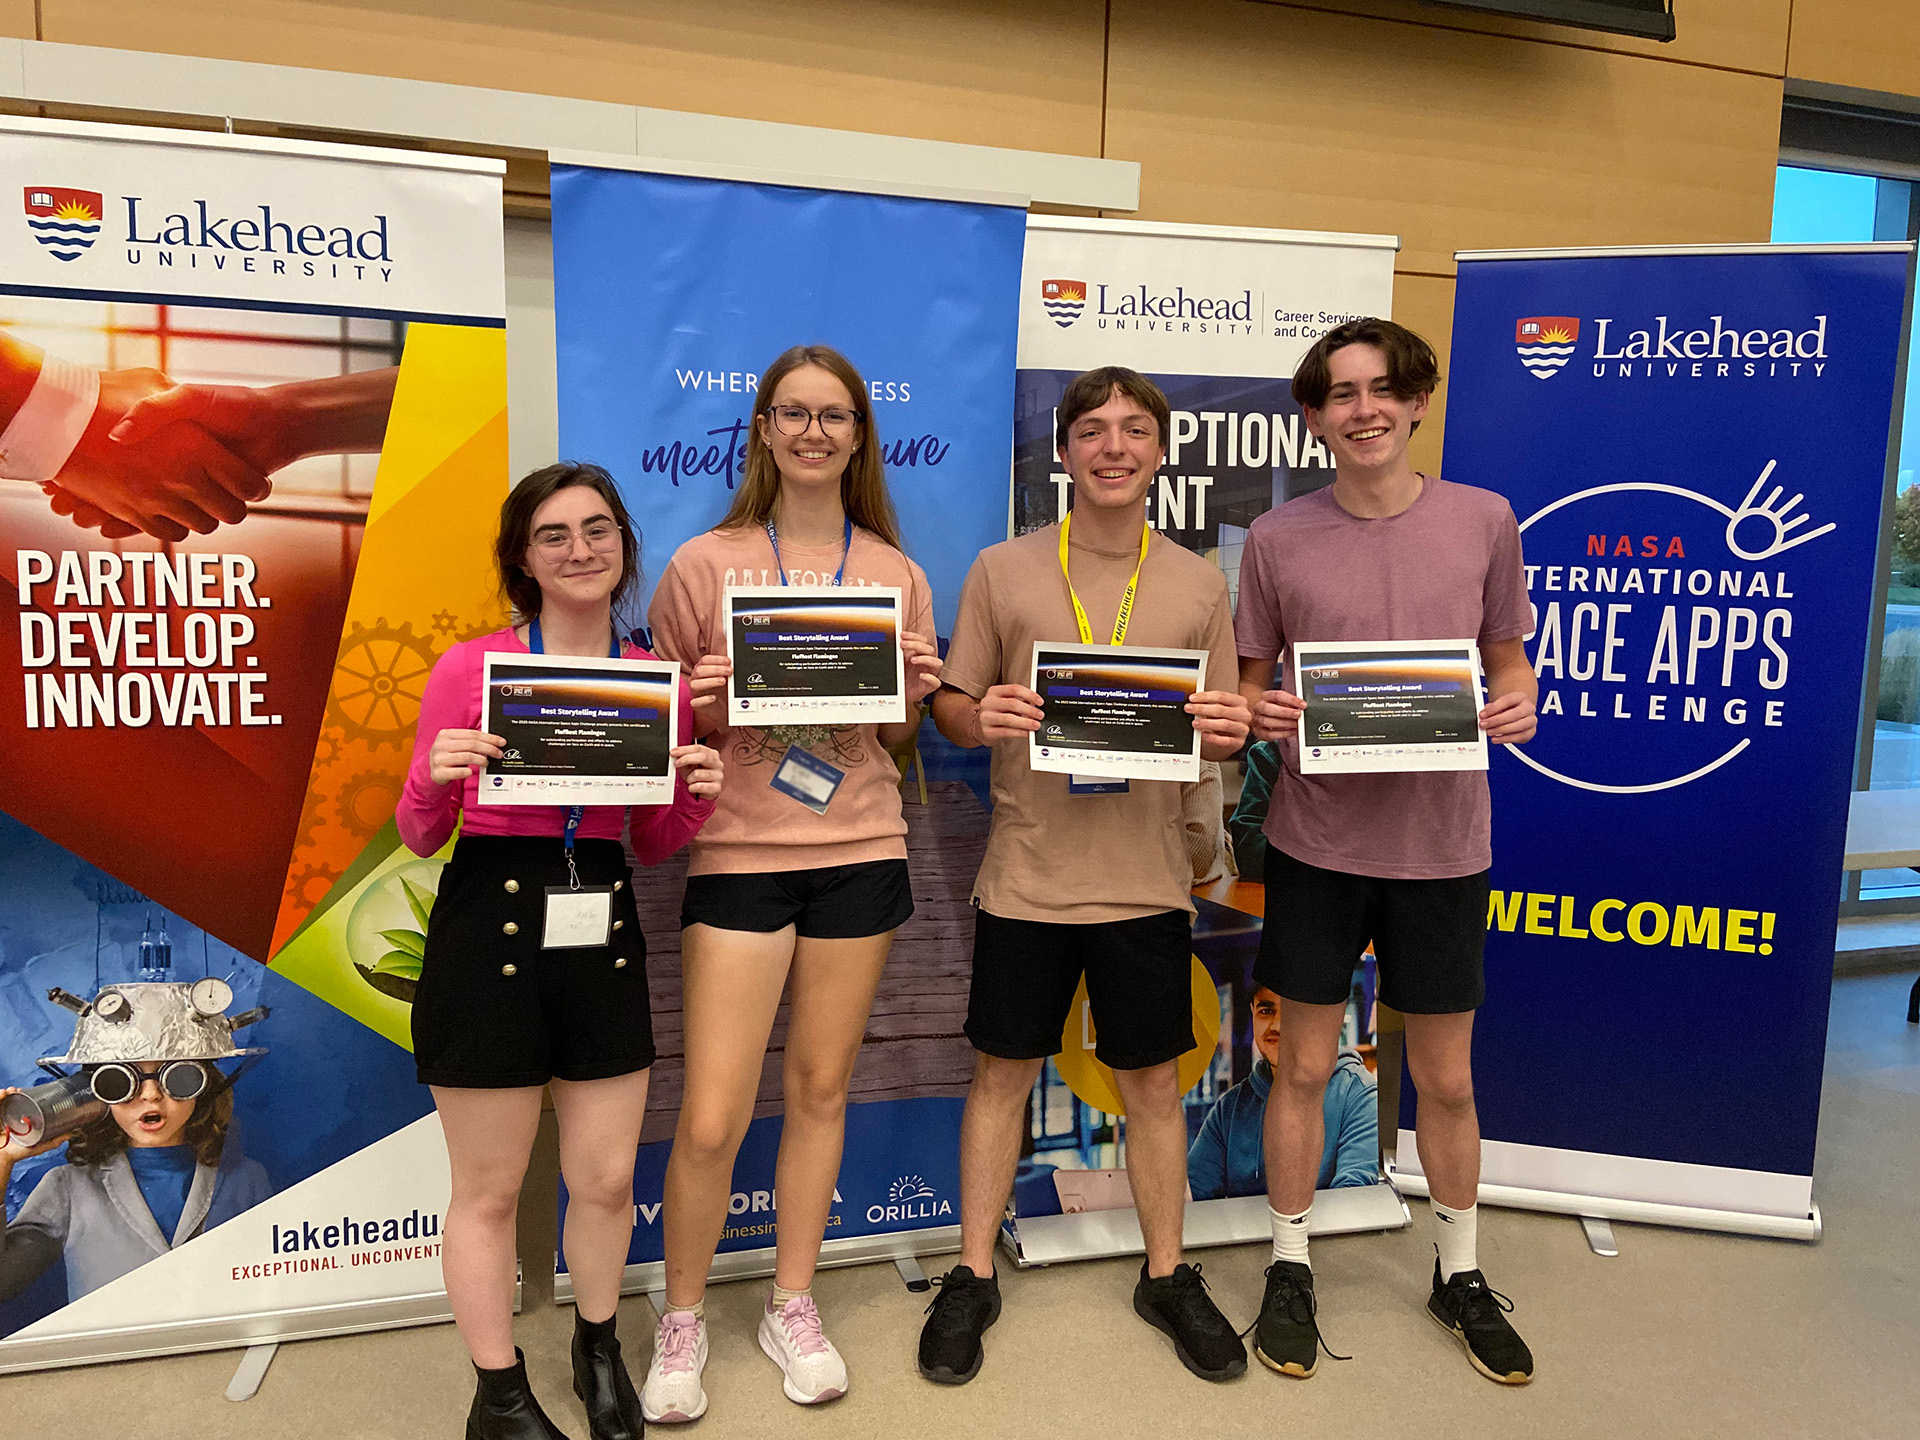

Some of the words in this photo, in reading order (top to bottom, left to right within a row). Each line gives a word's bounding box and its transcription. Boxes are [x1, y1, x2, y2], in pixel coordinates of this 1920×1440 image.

[121, 196, 393, 262] Lakehead
[127, 249, 392, 283] UNIVERSITY
[1097, 284, 1252, 322] Lakehead
[1274, 309, 1314, 323] Career
[1098, 318, 1252, 335] UNIVERSITY
[1274, 325, 1297, 337] and
[1301, 326, 1329, 338] Co-o
[1593, 315, 1828, 359] Lakehead
[675, 369, 758, 393] WHER
[1593, 363, 1826, 378] UNIVERSITY
[1586, 534, 1685, 558] NASA
[17, 550, 271, 607] PARTNER.
[1524, 565, 1794, 598] TERNATIONAL
[19, 612, 258, 667] DEVELOP.
[1647, 605, 1792, 690] APPS
[24, 672, 282, 728] INNOVATE.
[1541, 690, 1785, 727] ALLENGE
[1486, 890, 1776, 956] WELCOME!
[866, 1199, 952, 1223] ORILLIA
[272, 1209, 444, 1254] lakeheadu.
[232, 1256, 344, 1280] EXCEPTIONAL.
[351, 1243, 441, 1267] UNCONVENT
